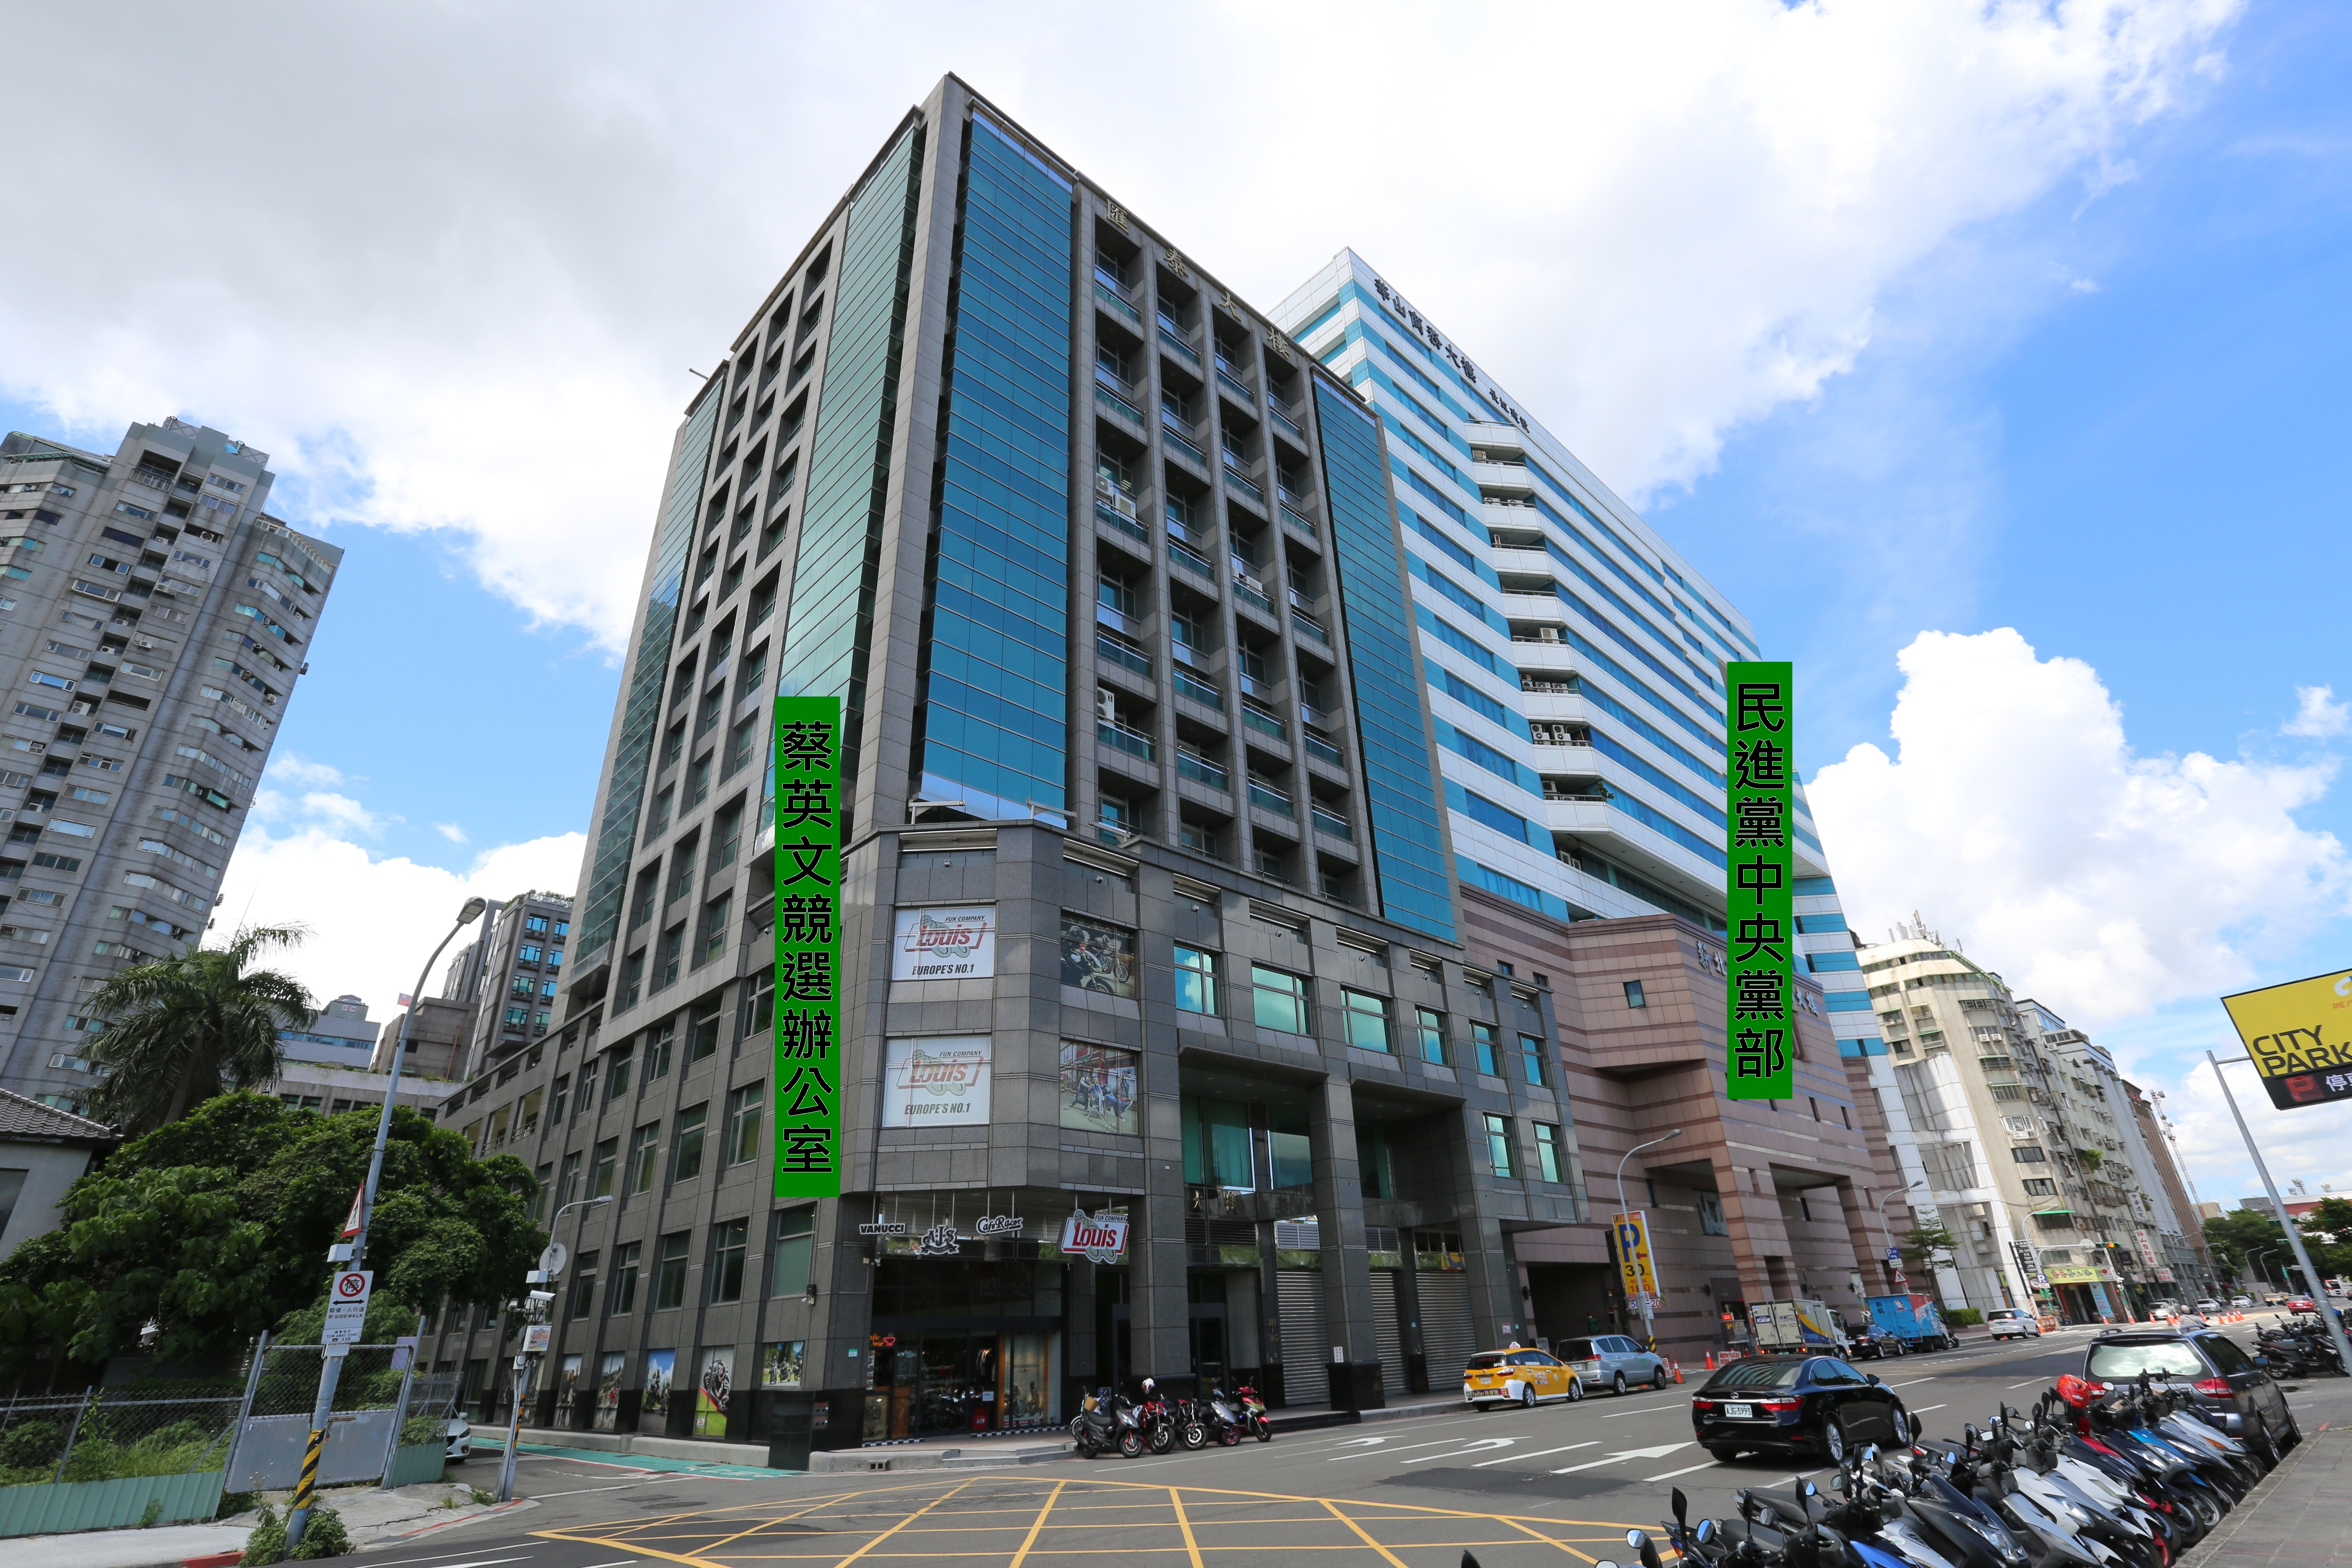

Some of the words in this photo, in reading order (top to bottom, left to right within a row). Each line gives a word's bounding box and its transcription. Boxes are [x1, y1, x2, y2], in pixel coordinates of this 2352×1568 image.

[1107, 198, 1290, 359] 匯泰大樓
[1374, 278, 1477, 383] 華山商務大樓
[916, 924, 972, 946] Louis
[912, 964, 953, 975] EUROPE'S
[955, 964, 974, 973] NO.1
[2253, 1025, 2322, 1056] CITY
[909, 1059, 968, 1083] Louis
[2261, 1042, 2352, 1077] PARK
[2285, 1076, 2314, 1102] P
[904, 1103, 948, 1115] EUROPE'S
[950, 1102, 971, 1113] NO.1
[860, 1224, 904, 1233] VANUCCI
[995, 1215, 1022, 1229] Racer
[1072, 1222, 1117, 1247] Louis
[1618, 1223, 1640, 1263] P
[345, 1278, 360, 1292] 停
[2038, 1275, 2045, 1283] P
[1651, 1299, 1661, 1307] 20
